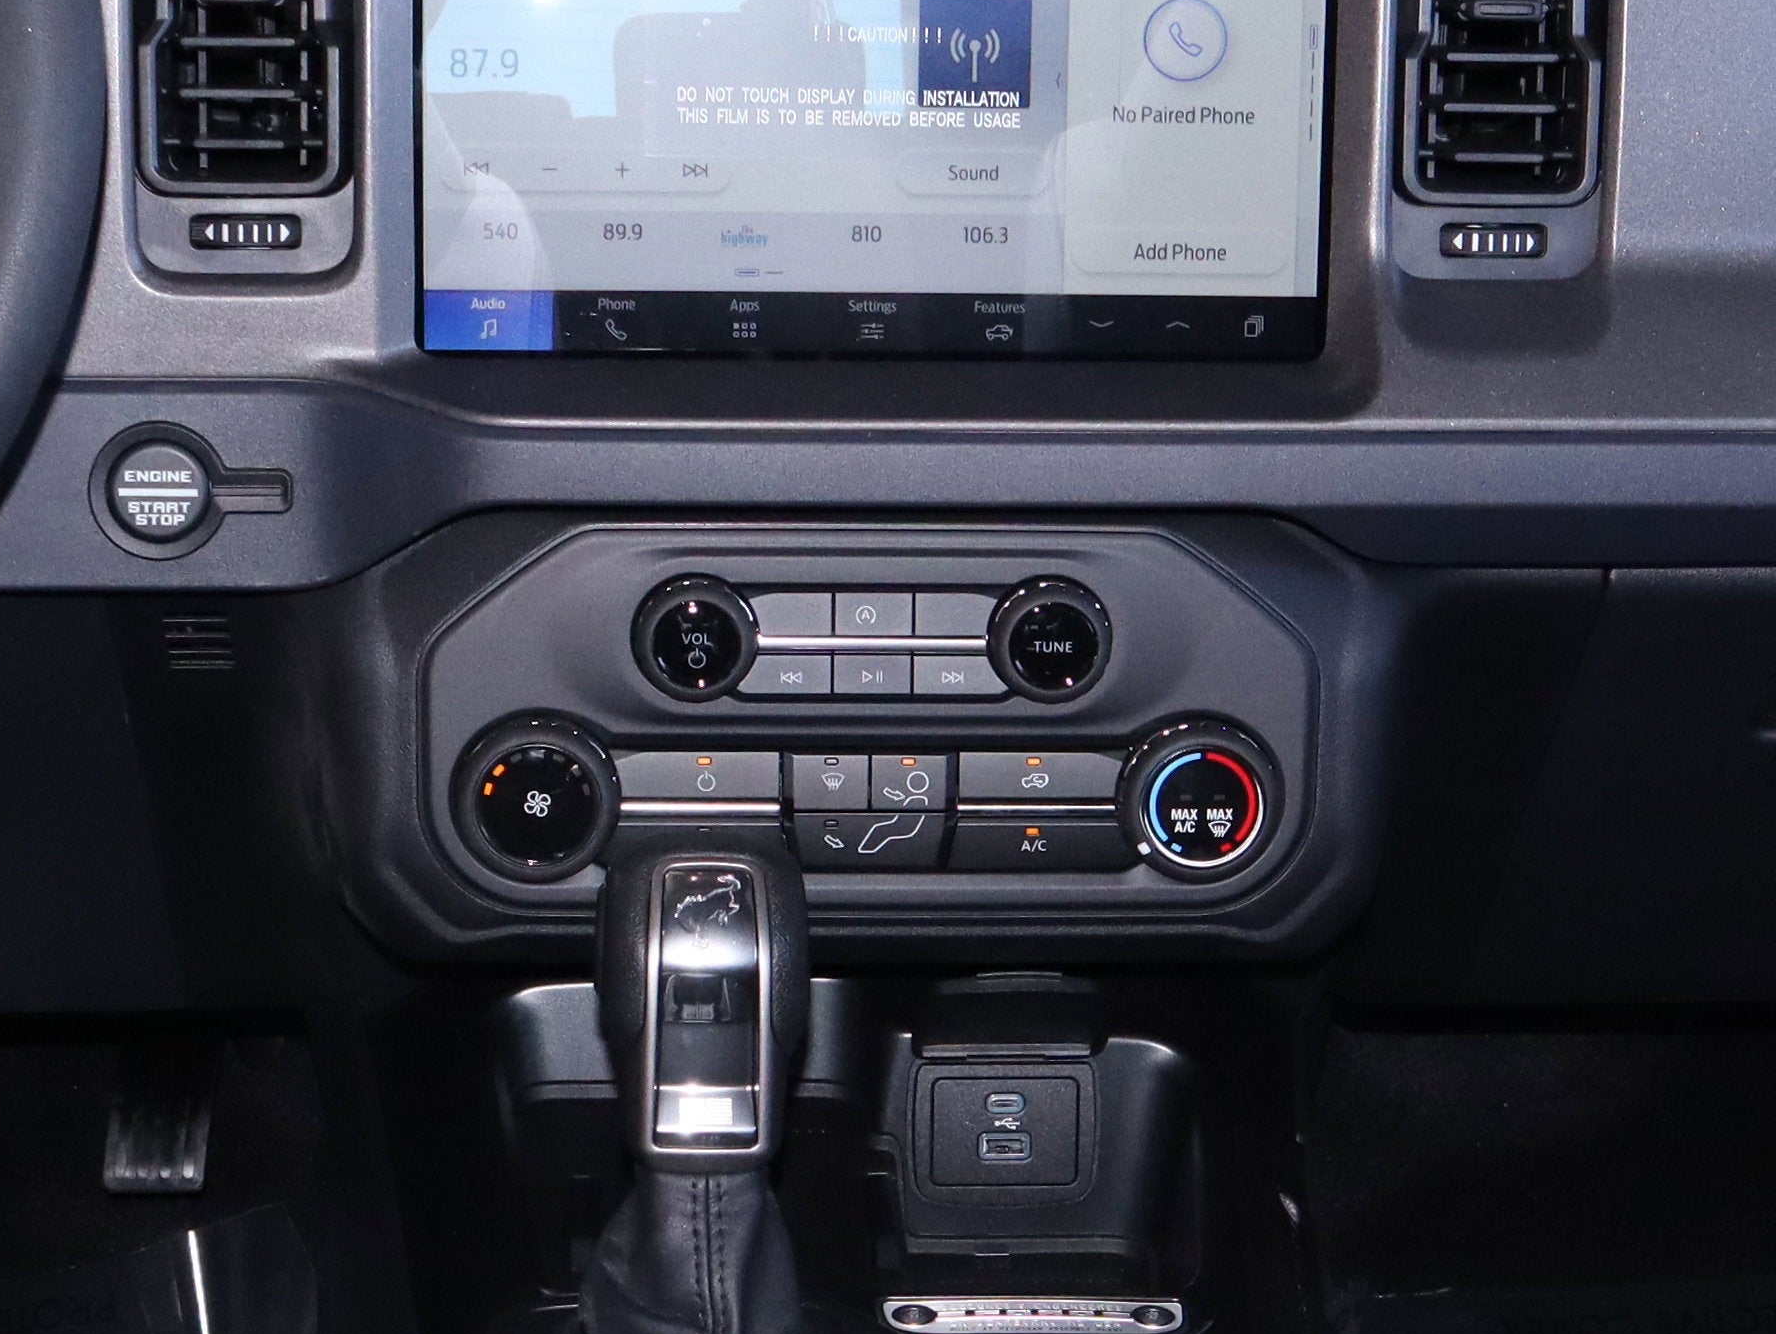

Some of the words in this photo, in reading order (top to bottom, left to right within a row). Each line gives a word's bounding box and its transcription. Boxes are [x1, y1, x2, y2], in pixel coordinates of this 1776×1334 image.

[450, 48, 520, 78] 87.9
[677, 87, 697, 103] DO
[705, 87, 733, 104] NOT
[742, 87, 789, 104] TOUCH
[798, 88, 855, 105] DISPLAY
[863, 89, 916, 106] DURING
[923, 90, 1019, 107] INSTALLATION
[677, 107, 708, 124] THIS
[717, 108, 748, 124] FILM
[756, 109, 769, 125] IS
[778, 109, 796, 125] TO
[805, 109, 824, 126] BE
[832, 110, 901, 127] REMOVED
[910, 111, 965, 128] BEFORE
[974, 112, 1020, 128] USAGE
[1113, 106, 1137, 124] No
[1141, 105, 1196, 124] Paired
[1200, 106, 1255, 125] Phone
[948, 165, 999, 182] Sound
[483, 223, 518, 240] 540
[603, 223, 642, 240] 89.9
[852, 226, 881, 243] 810
[963, 226, 1008, 244] 106.3
[1134, 243, 1168, 261] Add
[1173, 244, 1226, 262] Phone
[470, 297, 506, 310] Audio
[598, 298, 635, 311] Phone
[730, 299, 760, 313] Apps
[848, 300, 897, 315] Settings
[974, 300, 1025, 314] Features
[125, 470, 192, 483] ENGINE
[128, 502, 190, 514] START
[136, 514, 185, 526] STOP
[681, 632, 712, 646] VOL
[1034, 640, 1073, 653] TUNE
[1171, 808, 1198, 820] MAX
[1206, 808, 1233, 820] MAX
[1174, 822, 1195, 833] A/C
[1020, 838, 1049, 853] A/C
